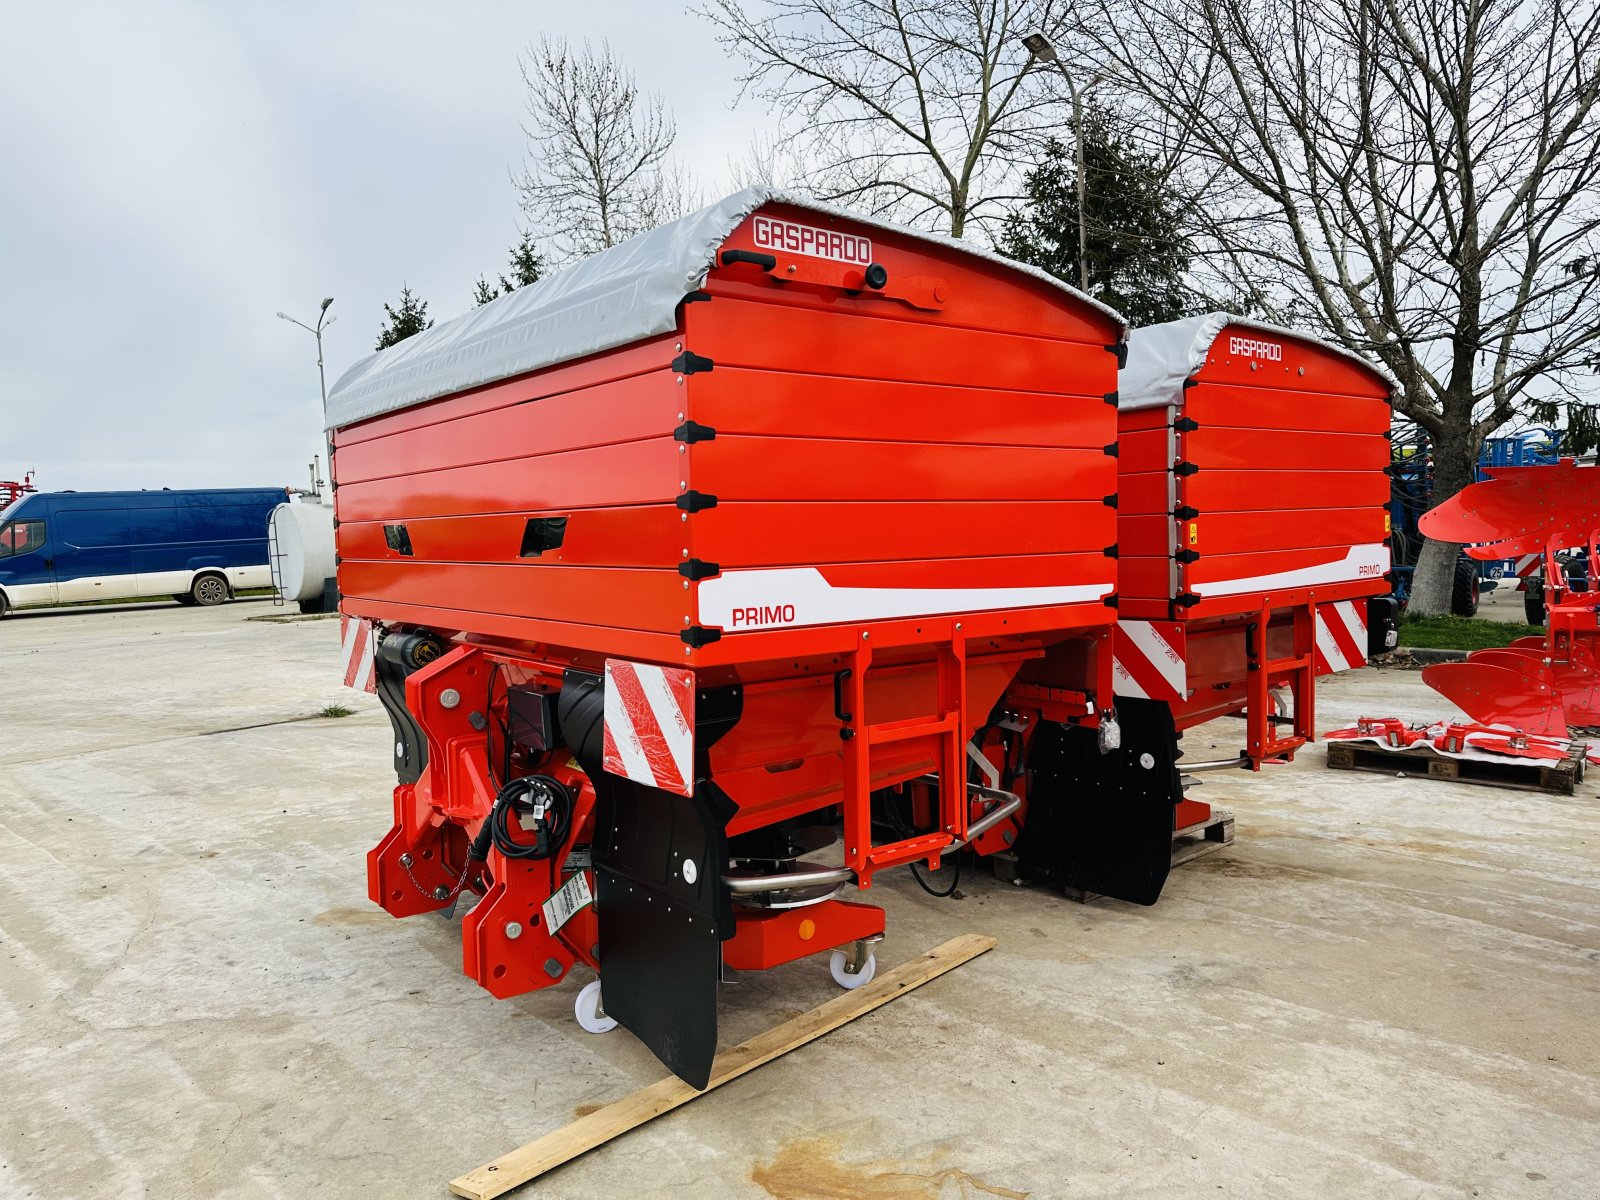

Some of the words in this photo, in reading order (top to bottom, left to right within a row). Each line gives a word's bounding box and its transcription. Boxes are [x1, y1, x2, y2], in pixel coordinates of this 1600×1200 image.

[755, 218, 871, 264] GASPARDO
[1229, 336, 1282, 362] GASPARDO
[1359, 564, 1381, 577] PRIMO
[1491, 567, 1503, 580] 25
[732, 604, 795, 627] PRIMO
